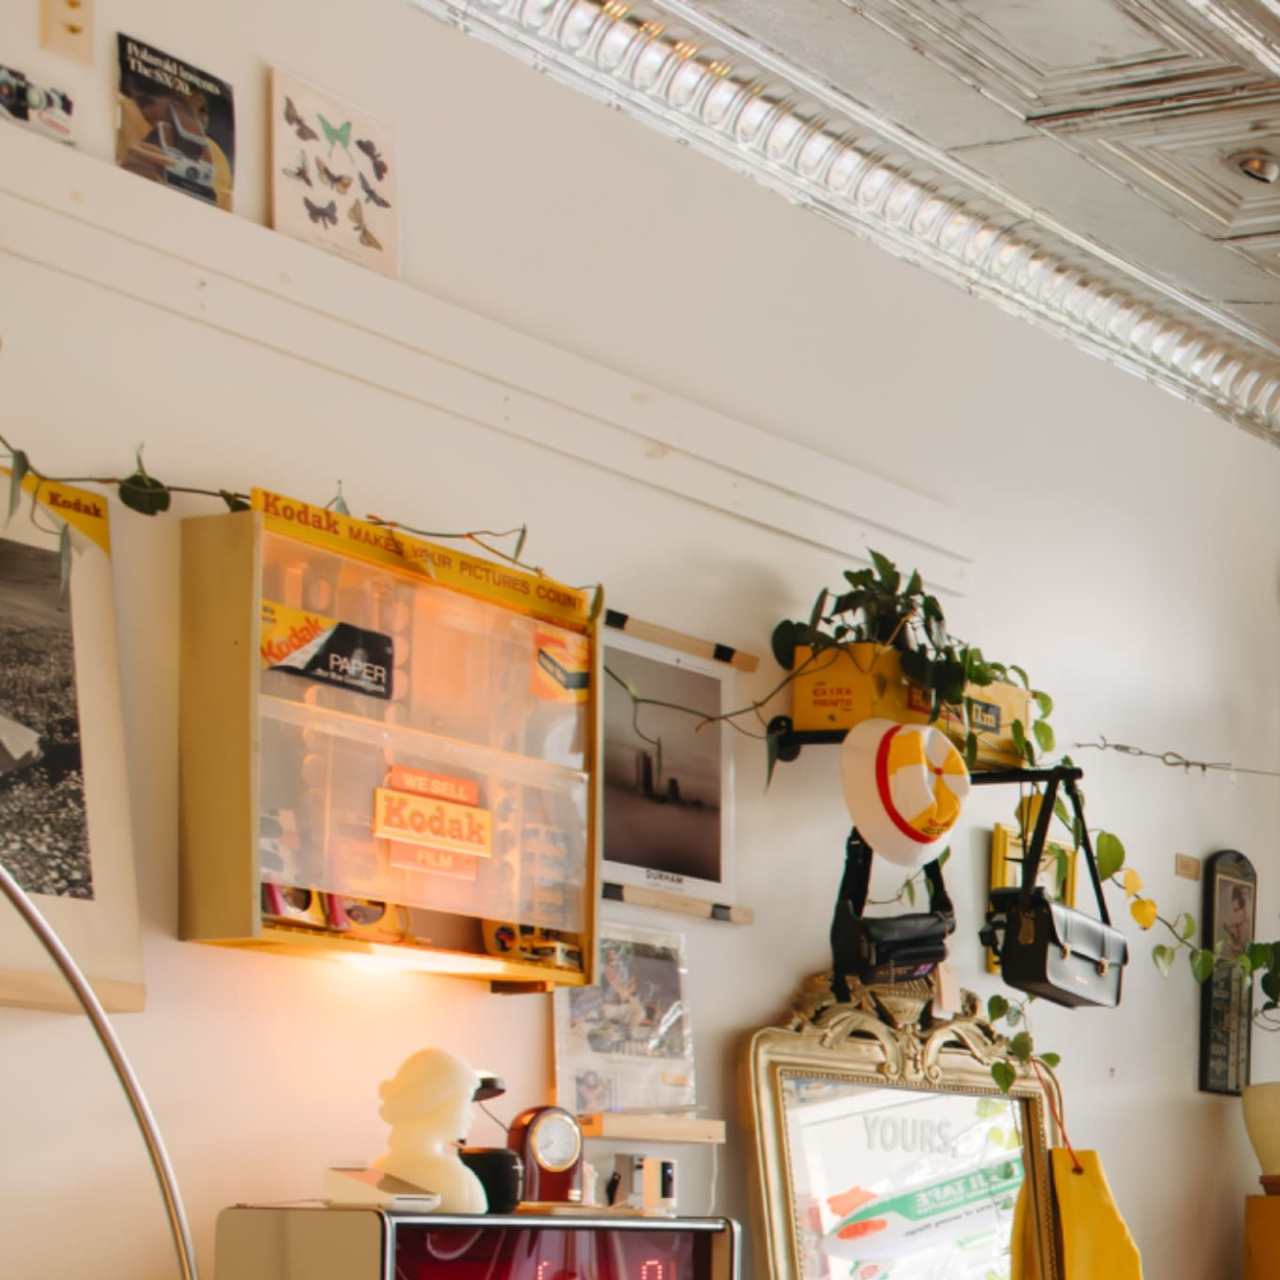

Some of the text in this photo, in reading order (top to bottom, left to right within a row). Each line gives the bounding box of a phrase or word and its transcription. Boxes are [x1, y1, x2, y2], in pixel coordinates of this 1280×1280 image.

[47, 491, 104, 519] Kodak
[261, 491, 341, 537] Kodak
[458, 560, 531, 596] PICTURES
[260, 615, 325, 664] Kodak
[329, 653, 386, 686] PAPER
[432, 778, 467, 801] SELL
[384, 795, 487, 846] Kodak
[415, 849, 453, 868] FILM
